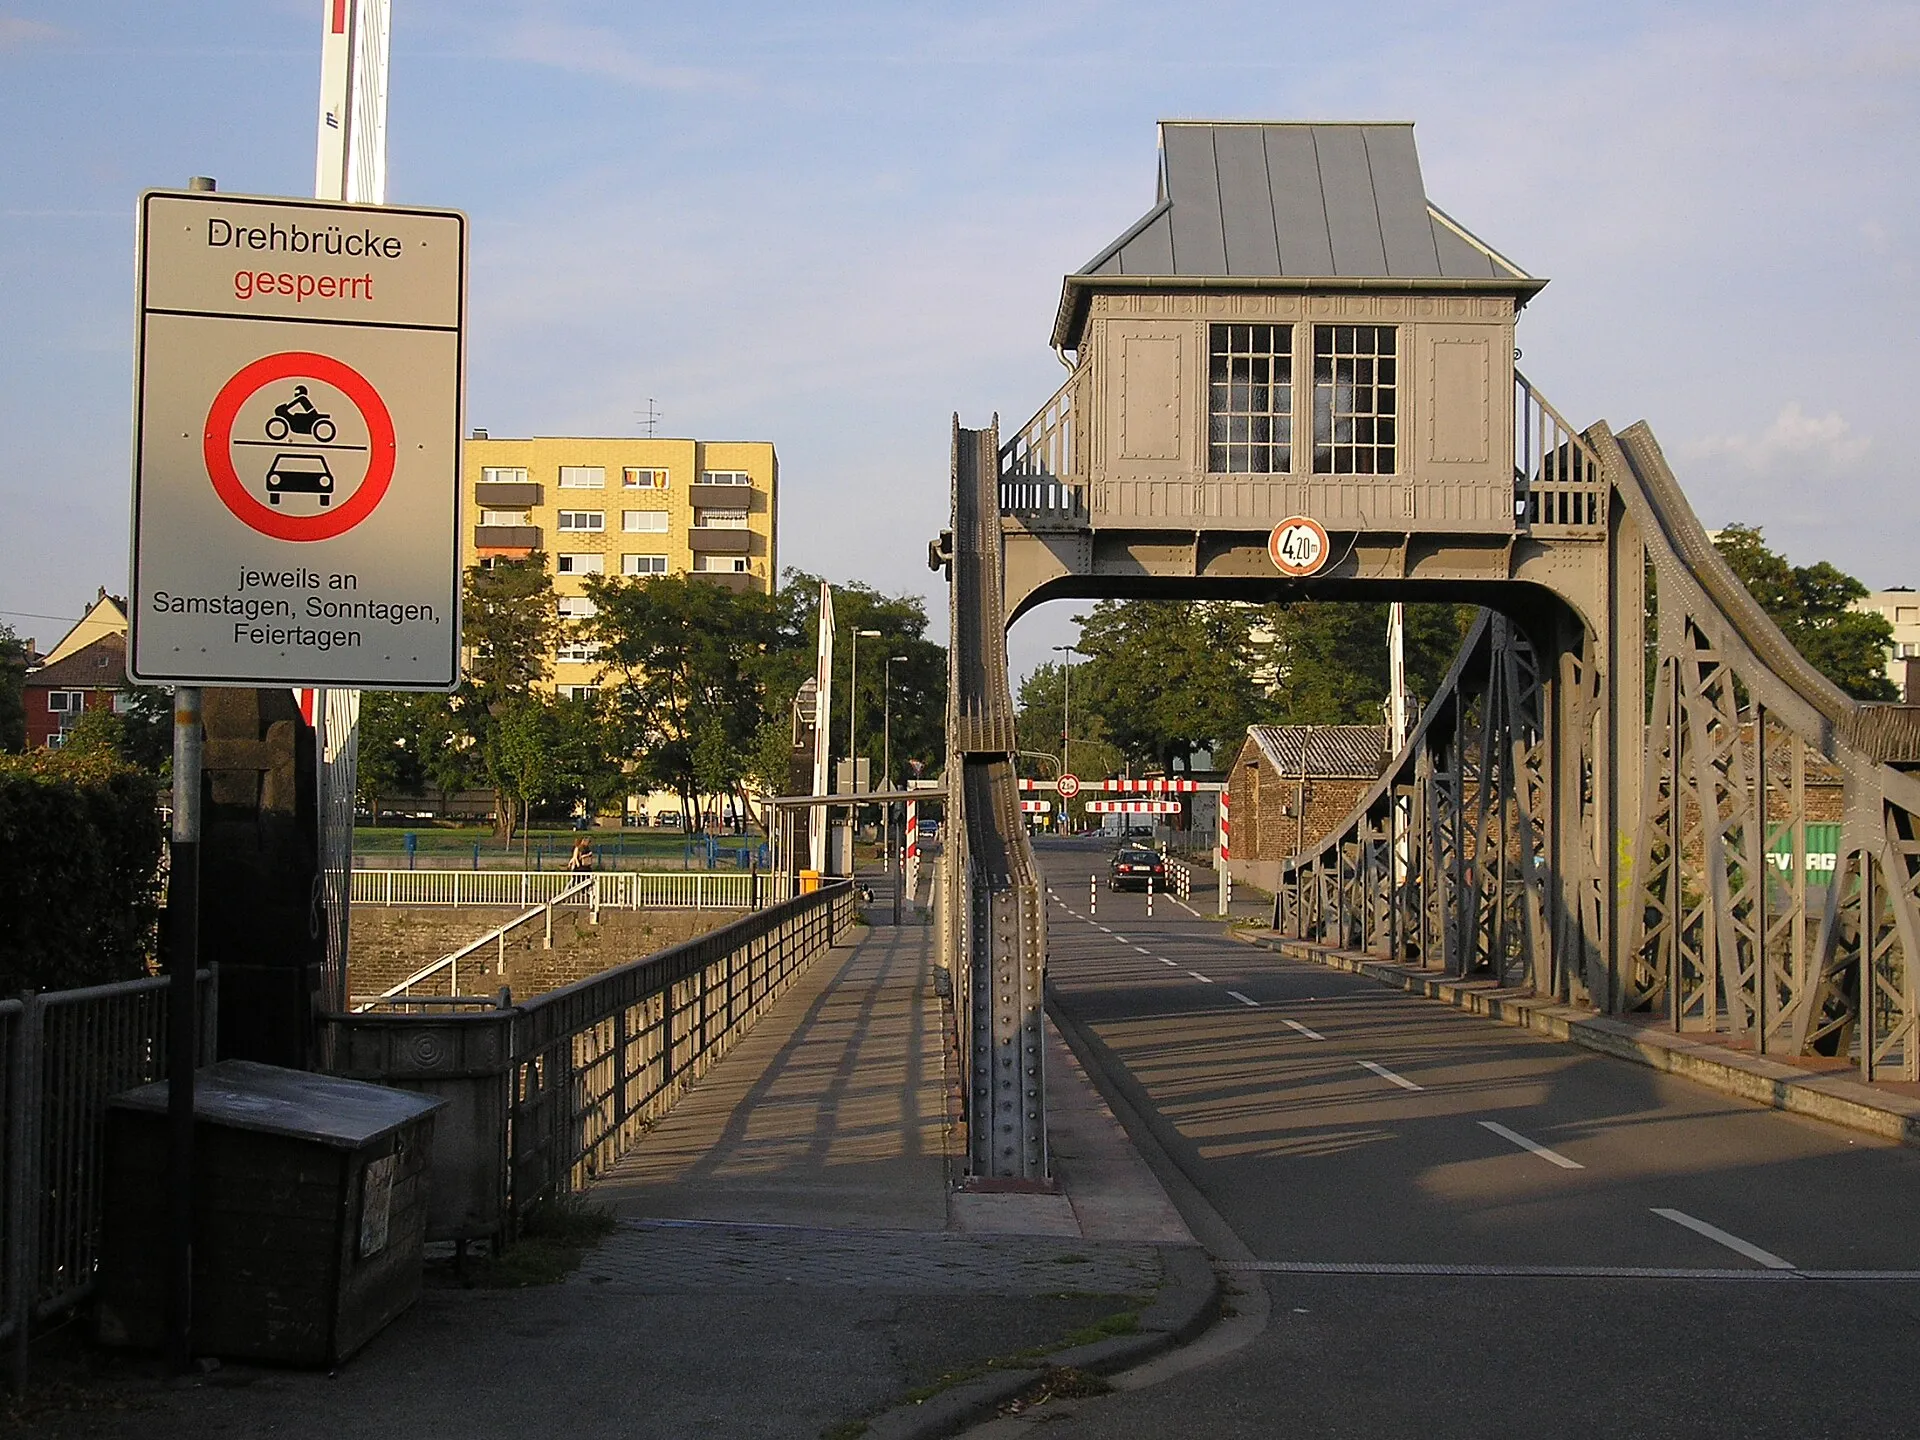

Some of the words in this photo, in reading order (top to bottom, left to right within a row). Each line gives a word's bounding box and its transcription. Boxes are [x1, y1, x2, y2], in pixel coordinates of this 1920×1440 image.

[208, 218, 402, 258] Drehbrücke
[234, 270, 373, 302] gesperrt
[238, 566, 320, 591] jeweils
[328, 573, 357, 589] an
[152, 591, 296, 620] Samstagen,
[305, 596, 441, 625] Sonntagen,
[233, 623, 361, 650] Feiertagen
